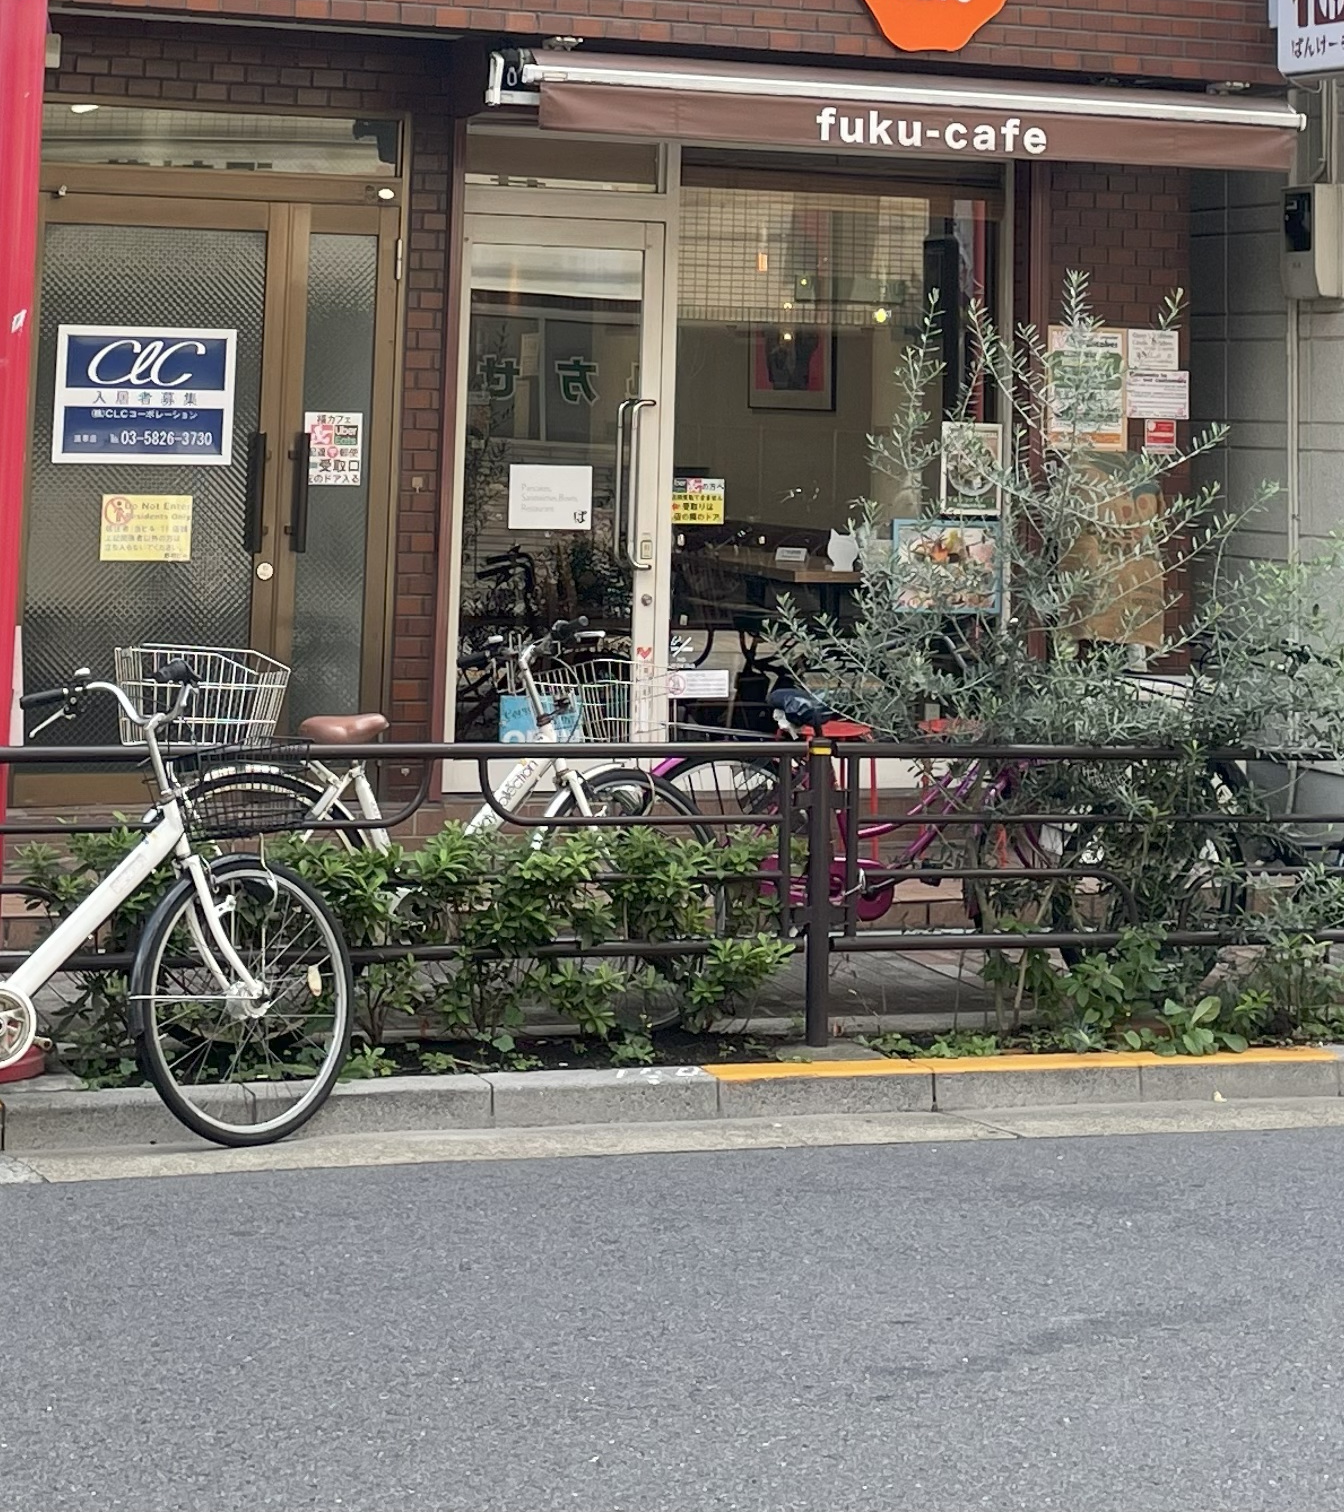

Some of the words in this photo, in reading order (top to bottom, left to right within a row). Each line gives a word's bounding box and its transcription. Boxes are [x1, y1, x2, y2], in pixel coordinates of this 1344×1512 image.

[816, 106, 1048, 155] fuku-cafe
[92, 390, 198, 406] 入居者募集
[120, 430, 213, 445] 03-5826-3730
[336, 426, 358, 435] Uber
[319, 458, 360, 472] 受取口
[141, 502, 160, 510] Not
